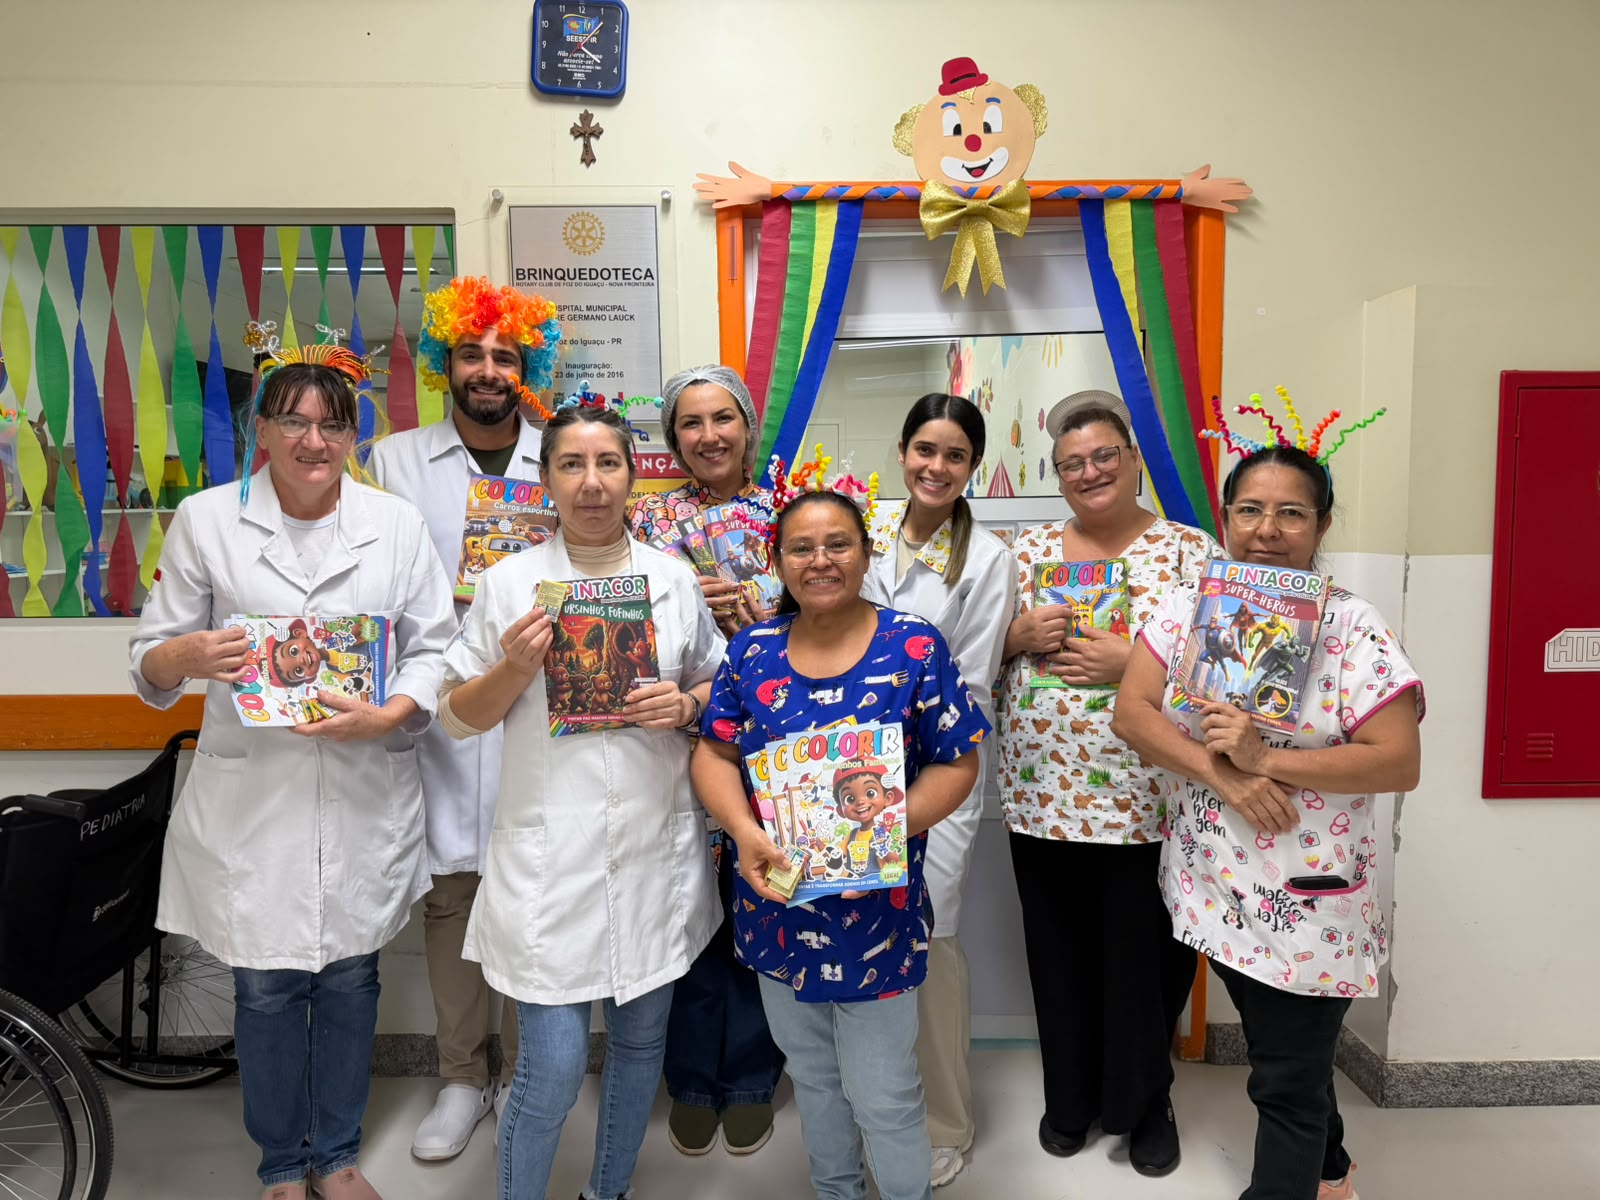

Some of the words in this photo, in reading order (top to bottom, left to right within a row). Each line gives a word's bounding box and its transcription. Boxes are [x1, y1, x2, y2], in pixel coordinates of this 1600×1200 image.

[578, 6, 586, 14] 12
[541, 20, 549, 28] 10
[614, 24, 620, 33] 2
[542, 40, 547, 49] 9
[614, 45, 619, 54] 3
[541, 61, 546, 70] 8
[612, 66, 618, 75] 4
[557, 79, 562, 87] 7
[577, 81, 582, 89] 6
[597, 81, 602, 89] 5
[515, 268, 655, 281] BRINQUEDOTECA
[556, 304, 584, 312] SPITAL
[585, 304, 628, 312] MUNICIPAL
[580, 338, 605, 346] Iguaçu
[565, 362, 613, 371] Inauguração:
[555, 371, 564, 379] 23
[565, 371, 574, 379] de
[575, 371, 595, 380] julho
[596, 371, 606, 379] de
[607, 371, 624, 379] 2016
[493, 501, 521, 512] Carros
[1040, 562, 1124, 589] COLORIR
[1225, 565, 1323, 595] PINTACOR
[564, 577, 647, 601] PINTACOR
[1224, 584, 1297, 617] SUPER-HERÓIS
[564, 603, 606, 617] URSINHOS
[608, 606, 645, 620] FOFINHOS
[1552, 636, 1600, 662] HID
[792, 727, 900, 763] COLORIR
[79, 793, 146, 841] PEDIATRIA
[1195, 818, 1227, 839] gem
